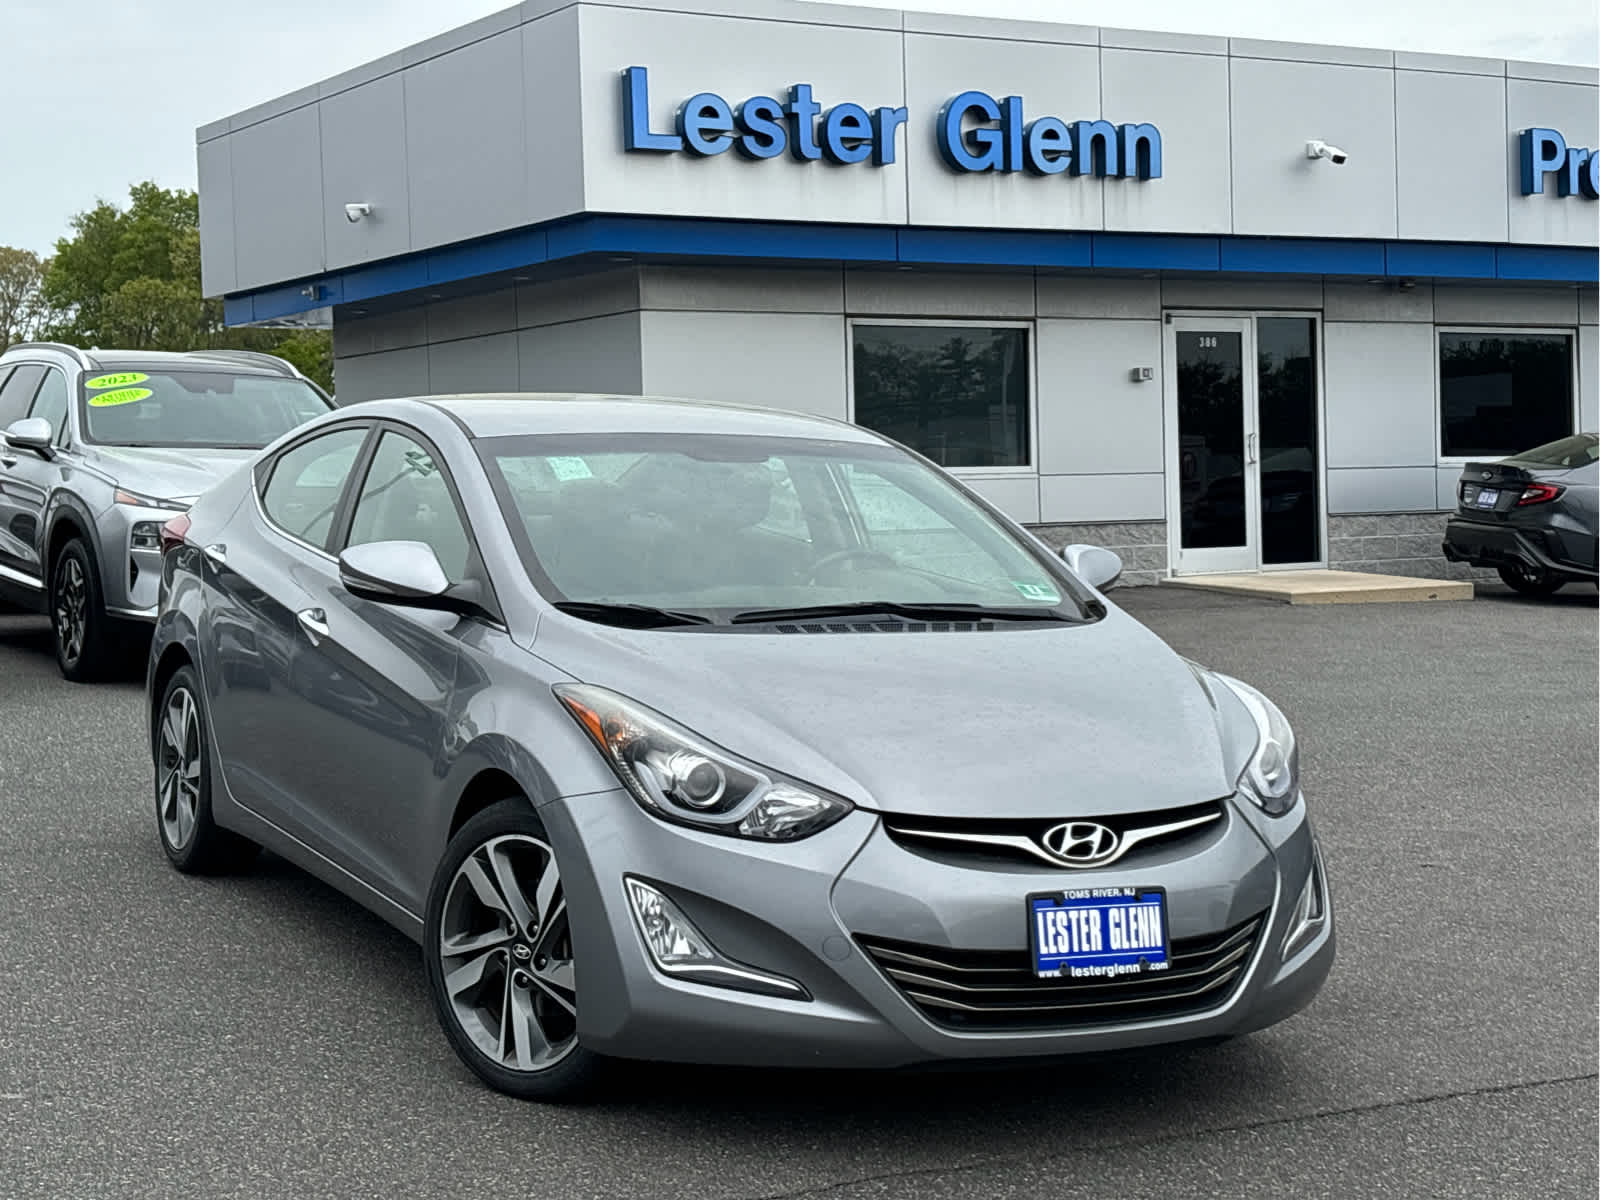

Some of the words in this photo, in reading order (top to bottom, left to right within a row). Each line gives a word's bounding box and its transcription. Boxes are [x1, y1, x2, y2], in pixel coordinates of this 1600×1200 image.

[622, 65, 907, 165] Lester
[937, 90, 1162, 180] Glenn
[1064, 890, 1090, 900] TOMS
[1124, 887, 1136, 897] NJ
[1036, 909, 1103, 955] LESTER
[1108, 906, 1162, 949] GLENN
[1071, 963, 1141, 978] lesterglenn
